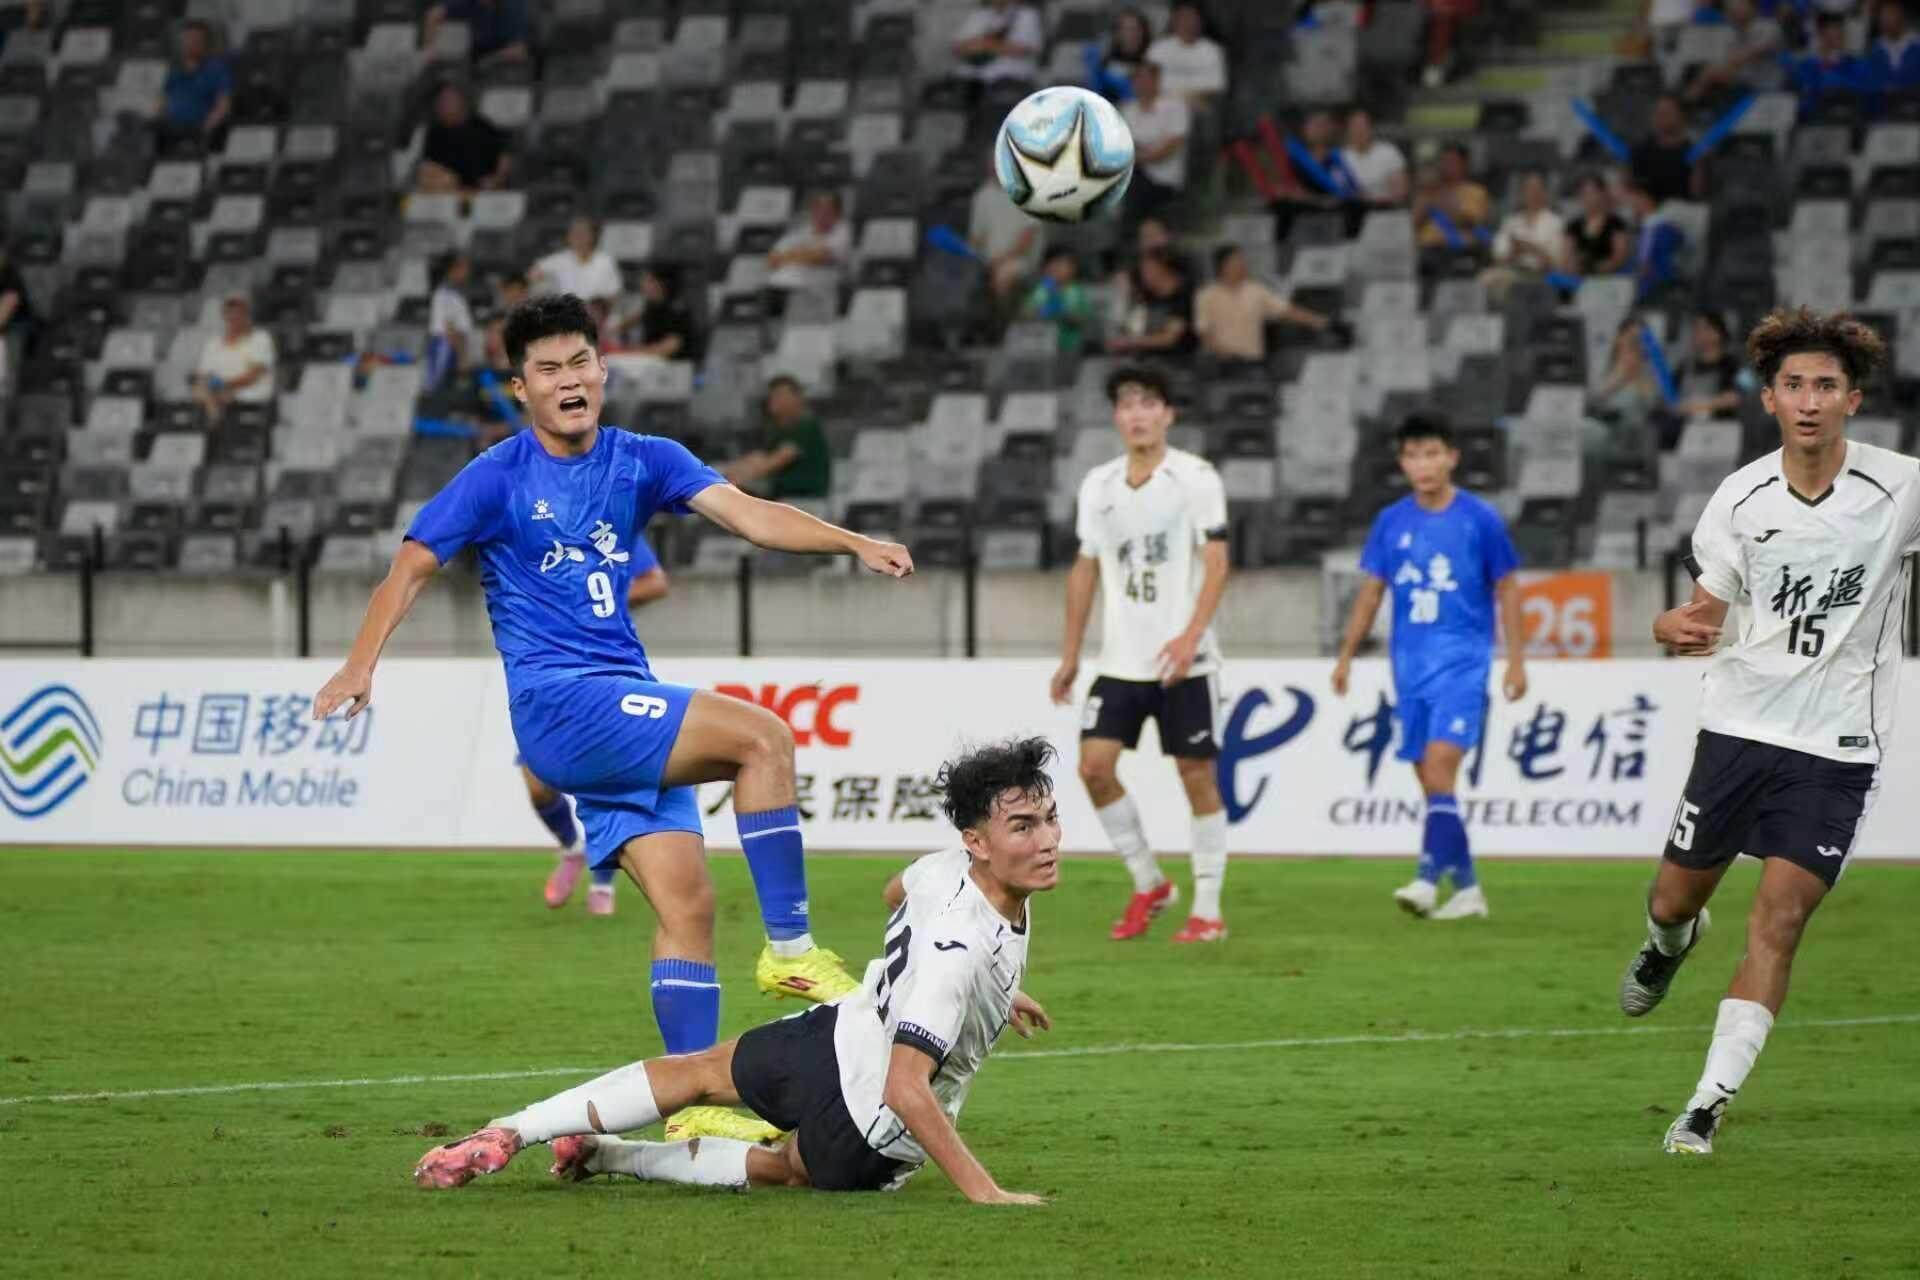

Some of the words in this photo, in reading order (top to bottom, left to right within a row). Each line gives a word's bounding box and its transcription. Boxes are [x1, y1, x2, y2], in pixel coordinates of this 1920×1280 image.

[587, 571, 615, 618] 9
[1521, 596, 1597, 657] 26
[1787, 613, 1828, 658] 15
[620, 693, 668, 719] 9
[1343, 690, 1660, 787] 中电信
[121, 767, 228, 808] China
[237, 768, 359, 808] Mobile
[1329, 799, 1424, 826] CHIN
[1463, 799, 1643, 827] TELECOM
